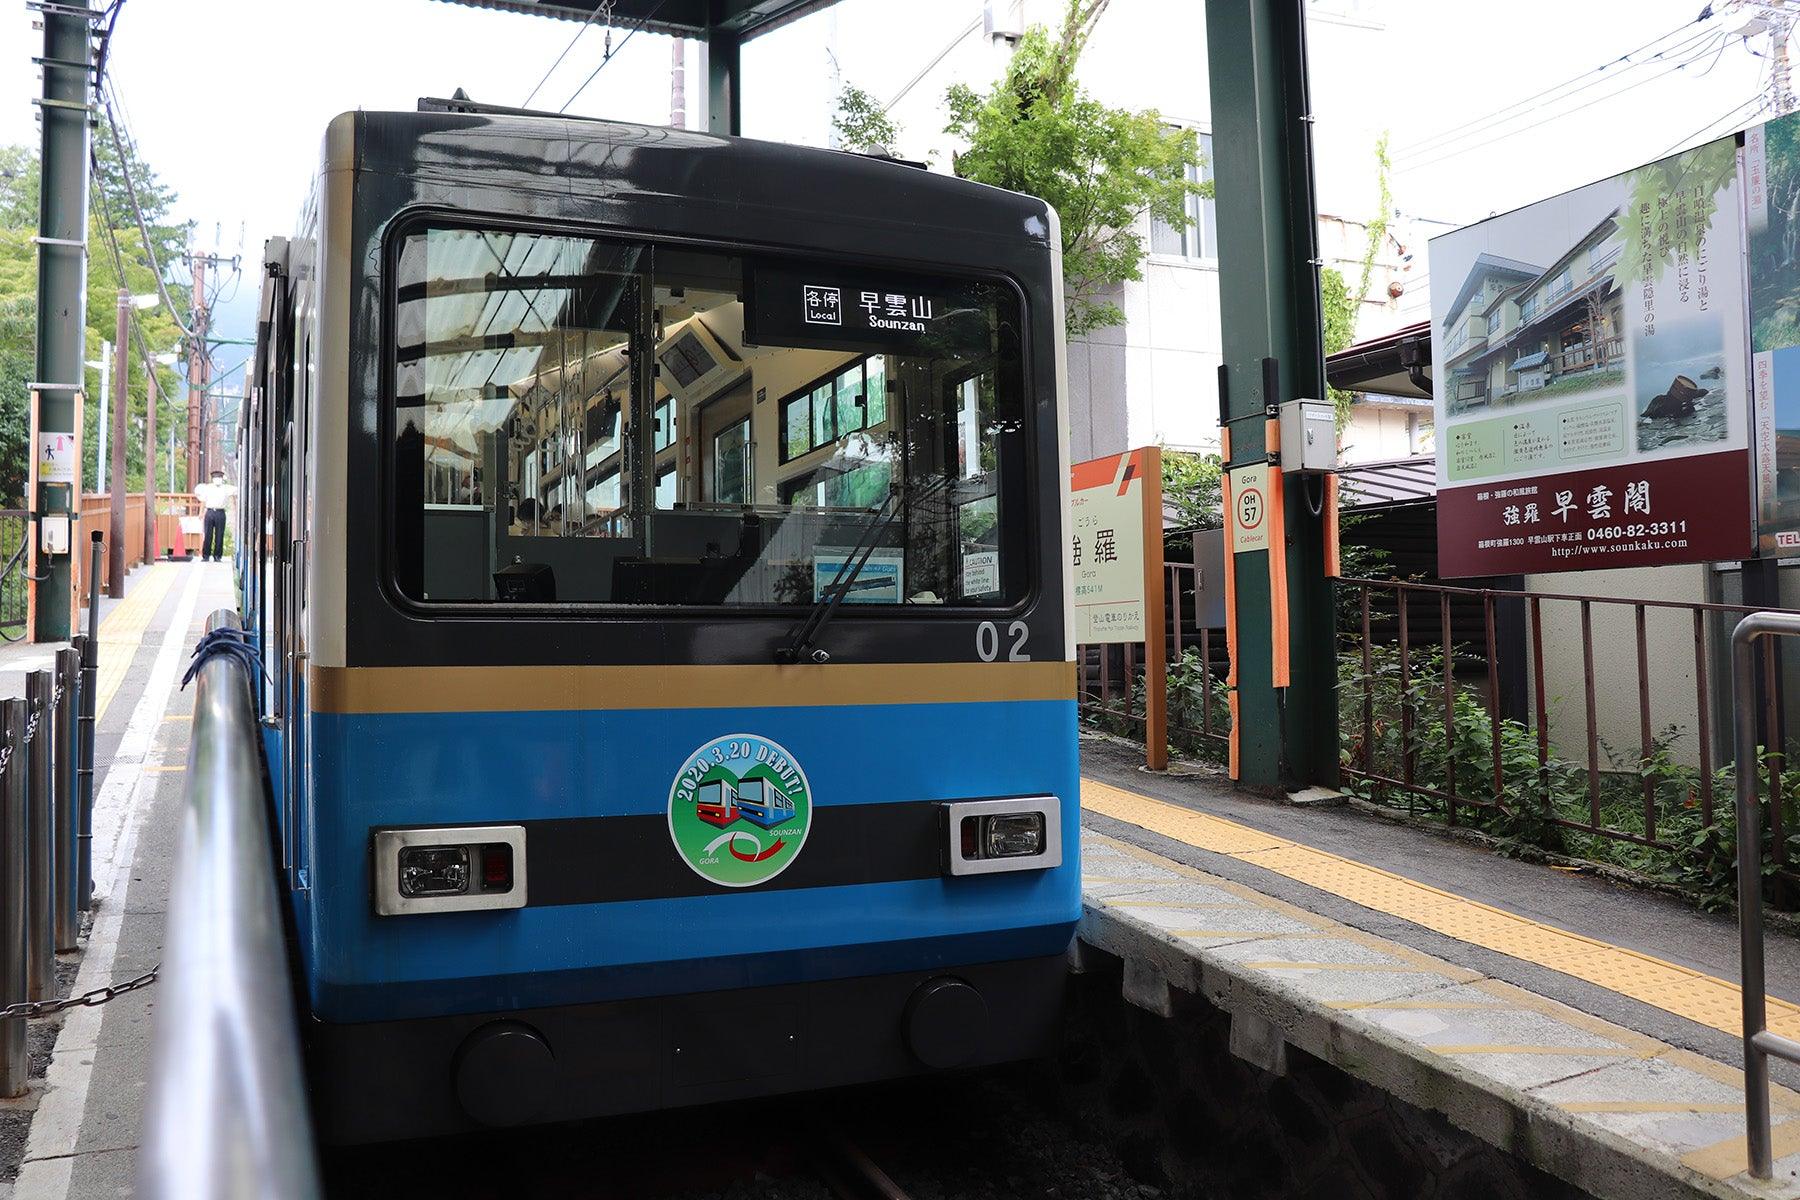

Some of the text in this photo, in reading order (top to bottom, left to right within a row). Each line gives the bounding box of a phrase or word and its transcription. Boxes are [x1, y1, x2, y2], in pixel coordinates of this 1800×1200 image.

[806, 290, 839, 308] 各停
[859, 291, 932, 319] 早雲山
[810, 309, 836, 321] Local
[868, 314, 925, 332] Sounzan
[1241, 475, 1257, 485] Gora
[1243, 494, 1256, 505] OH
[1502, 480, 1651, 526] 強羅 早雲閣
[1244, 507, 1257, 522] 57
[1240, 534, 1264, 544] Cablecar
[1587, 520, 1687, 541] 0460-82-3311
[1551, 539, 1688, 558] http://www.sounkaku.com
[975, 620, 1031, 663] 02
[676, 741, 804, 802] 2020.3.20 DEBUT!
[769, 829, 802, 837] SOUNZAN
[699, 857, 720, 865] GORA
